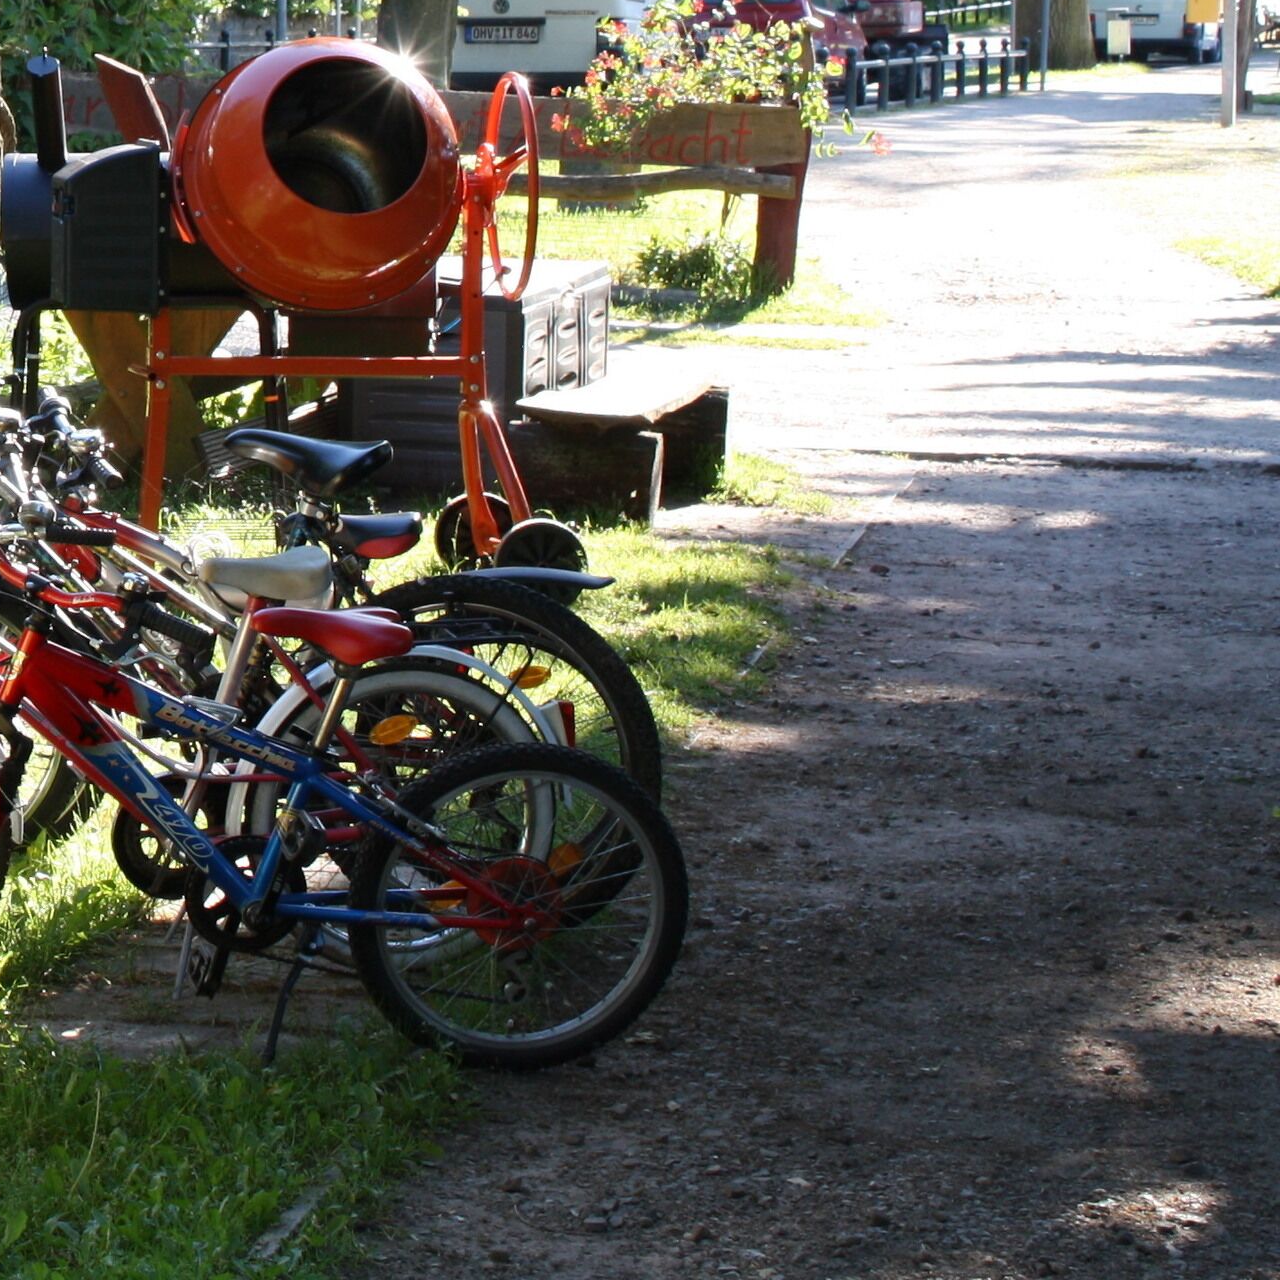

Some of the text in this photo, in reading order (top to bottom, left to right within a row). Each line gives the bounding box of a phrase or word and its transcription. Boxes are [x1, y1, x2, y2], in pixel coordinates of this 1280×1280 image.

[472, 26, 538, 40] OHV IT 846
